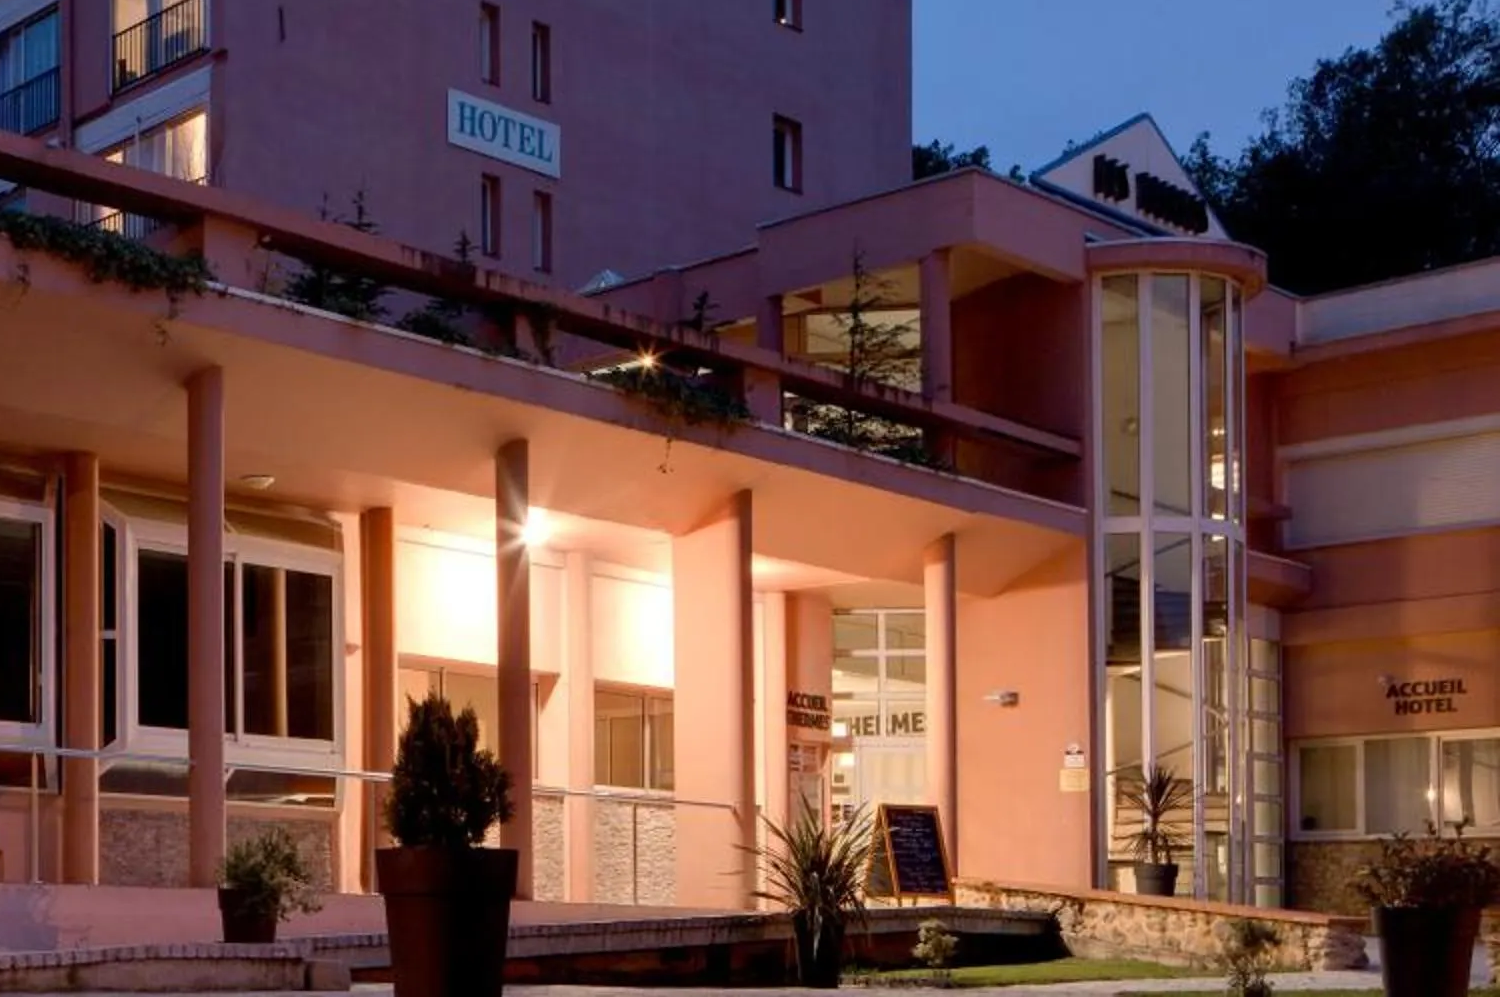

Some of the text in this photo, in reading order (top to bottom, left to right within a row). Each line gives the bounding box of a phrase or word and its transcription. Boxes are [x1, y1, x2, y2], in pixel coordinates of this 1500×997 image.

[457, 100, 553, 163] HOTEL
[1386, 678, 1467, 699] ACCUEIL
[1395, 698, 1458, 715] HOTEL
